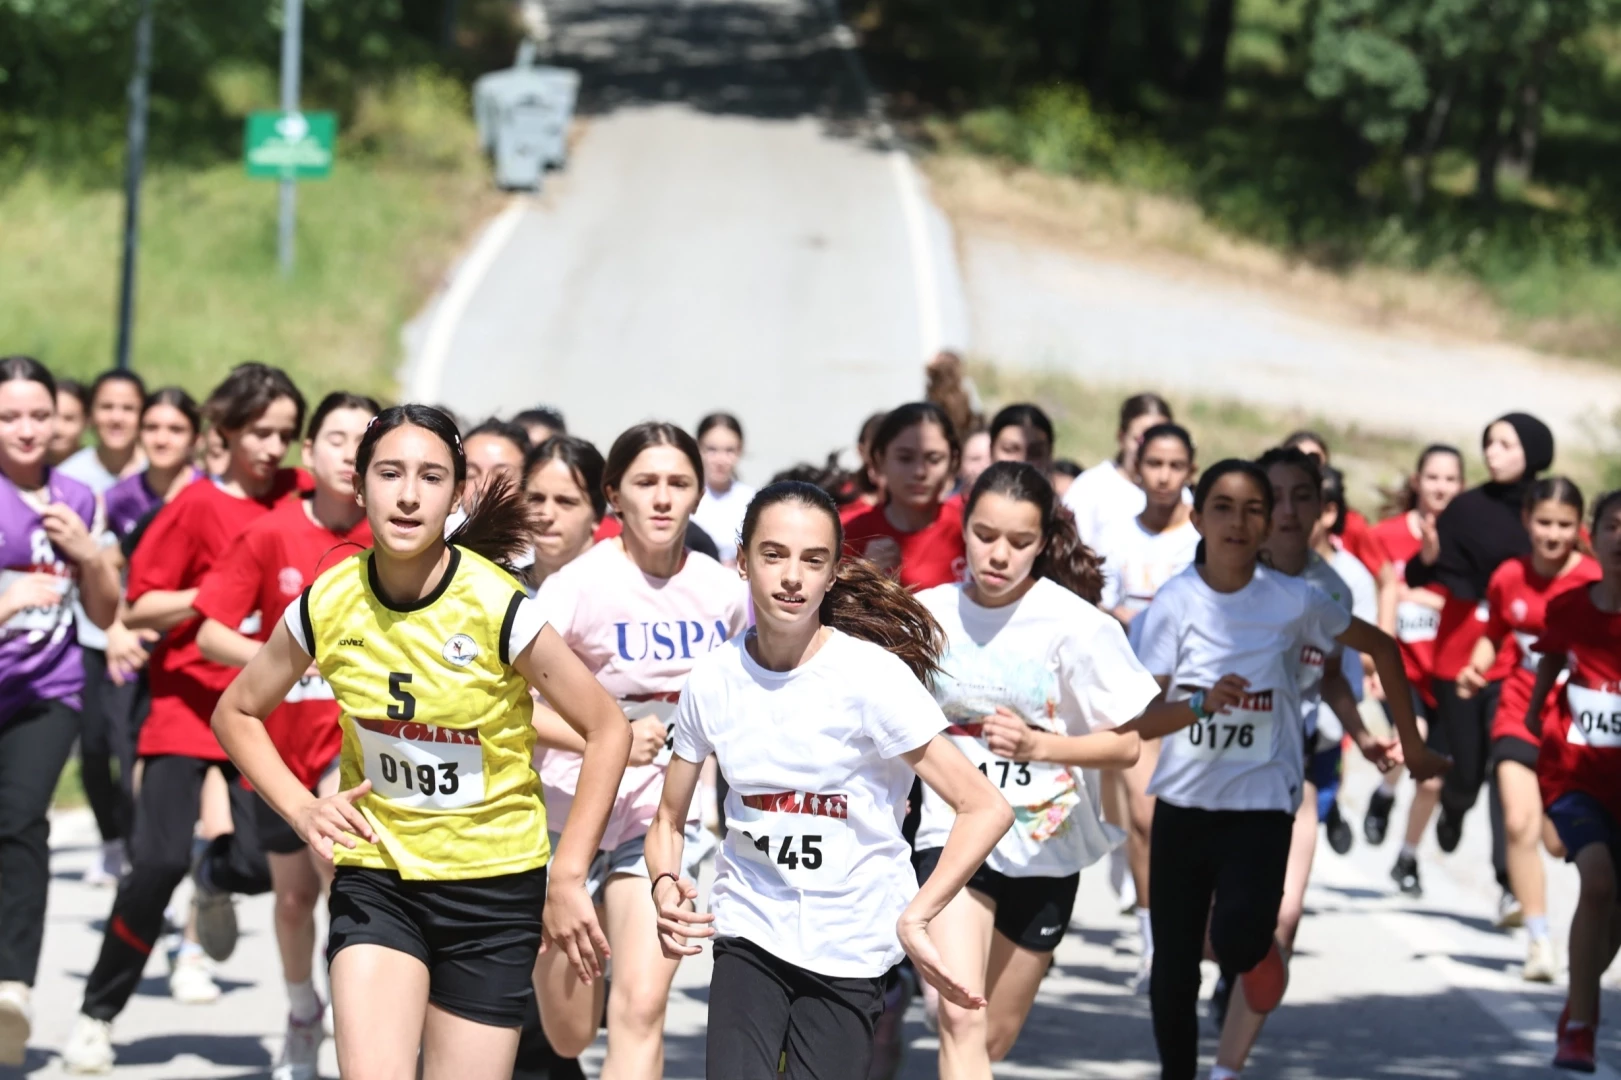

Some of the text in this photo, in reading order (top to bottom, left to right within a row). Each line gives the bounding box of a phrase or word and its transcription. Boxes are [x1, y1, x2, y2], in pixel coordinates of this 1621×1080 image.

[614, 620, 727, 661] USPA
[387, 672, 416, 721] 5
[1190, 722, 1253, 749] 0176
[380, 753, 459, 796] 0193
[742, 831, 823, 870] 145
